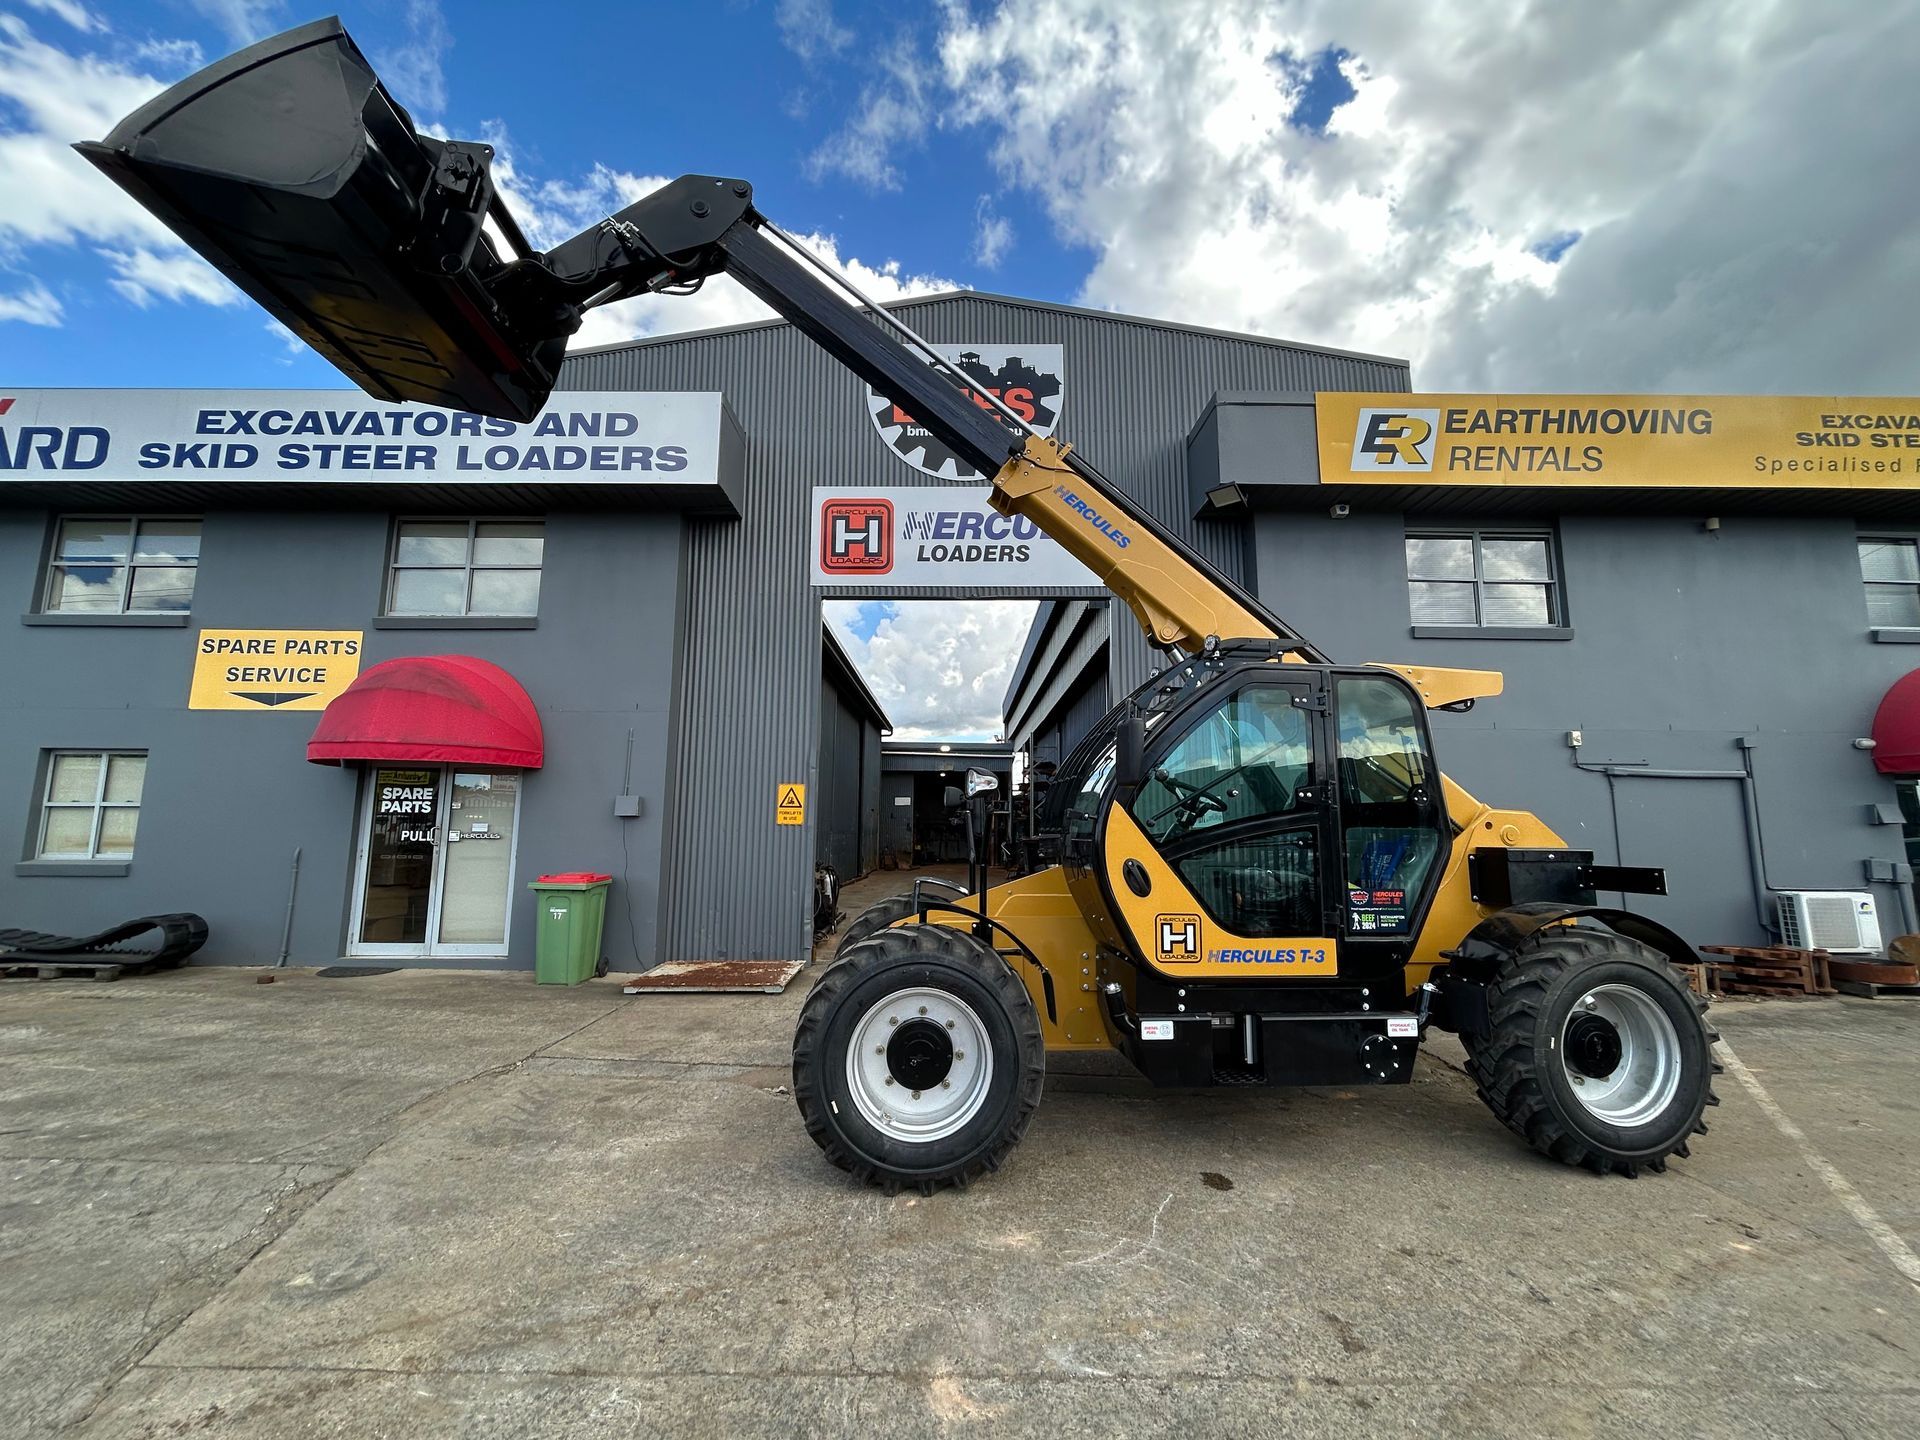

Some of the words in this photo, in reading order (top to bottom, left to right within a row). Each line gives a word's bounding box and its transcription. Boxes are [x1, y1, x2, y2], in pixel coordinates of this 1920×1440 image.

[195, 410, 517, 438] EXCAVATORS
[533, 412, 639, 437] AND
[1445, 408, 1712, 435] EARTHMOVING
[1360, 413, 1431, 465] ER
[1796, 432, 1861, 447] SKID
[1870, 433, 1920, 448] STE
[138, 443, 259, 469] SKID
[277, 444, 438, 470] STEER
[456, 445, 688, 471] LOADERS
[1449, 446, 1603, 472] RENTALS
[1755, 456, 1902, 475] Specialised
[1053, 485, 1131, 549] HERCULES
[917, 545, 1031, 562] LOADERS
[202, 639, 276, 654] SPARE
[284, 640, 358, 655] PARTS
[226, 667, 327, 683] SERVICE
[382, 787, 433, 800] SPARE
[380, 800, 431, 813] PARTS
[401, 830, 434, 842] PULL
[1362, 914, 1375, 922] BEEF
[1207, 950, 1296, 963] HERCULES
[1301, 950, 1325, 963] T-3
